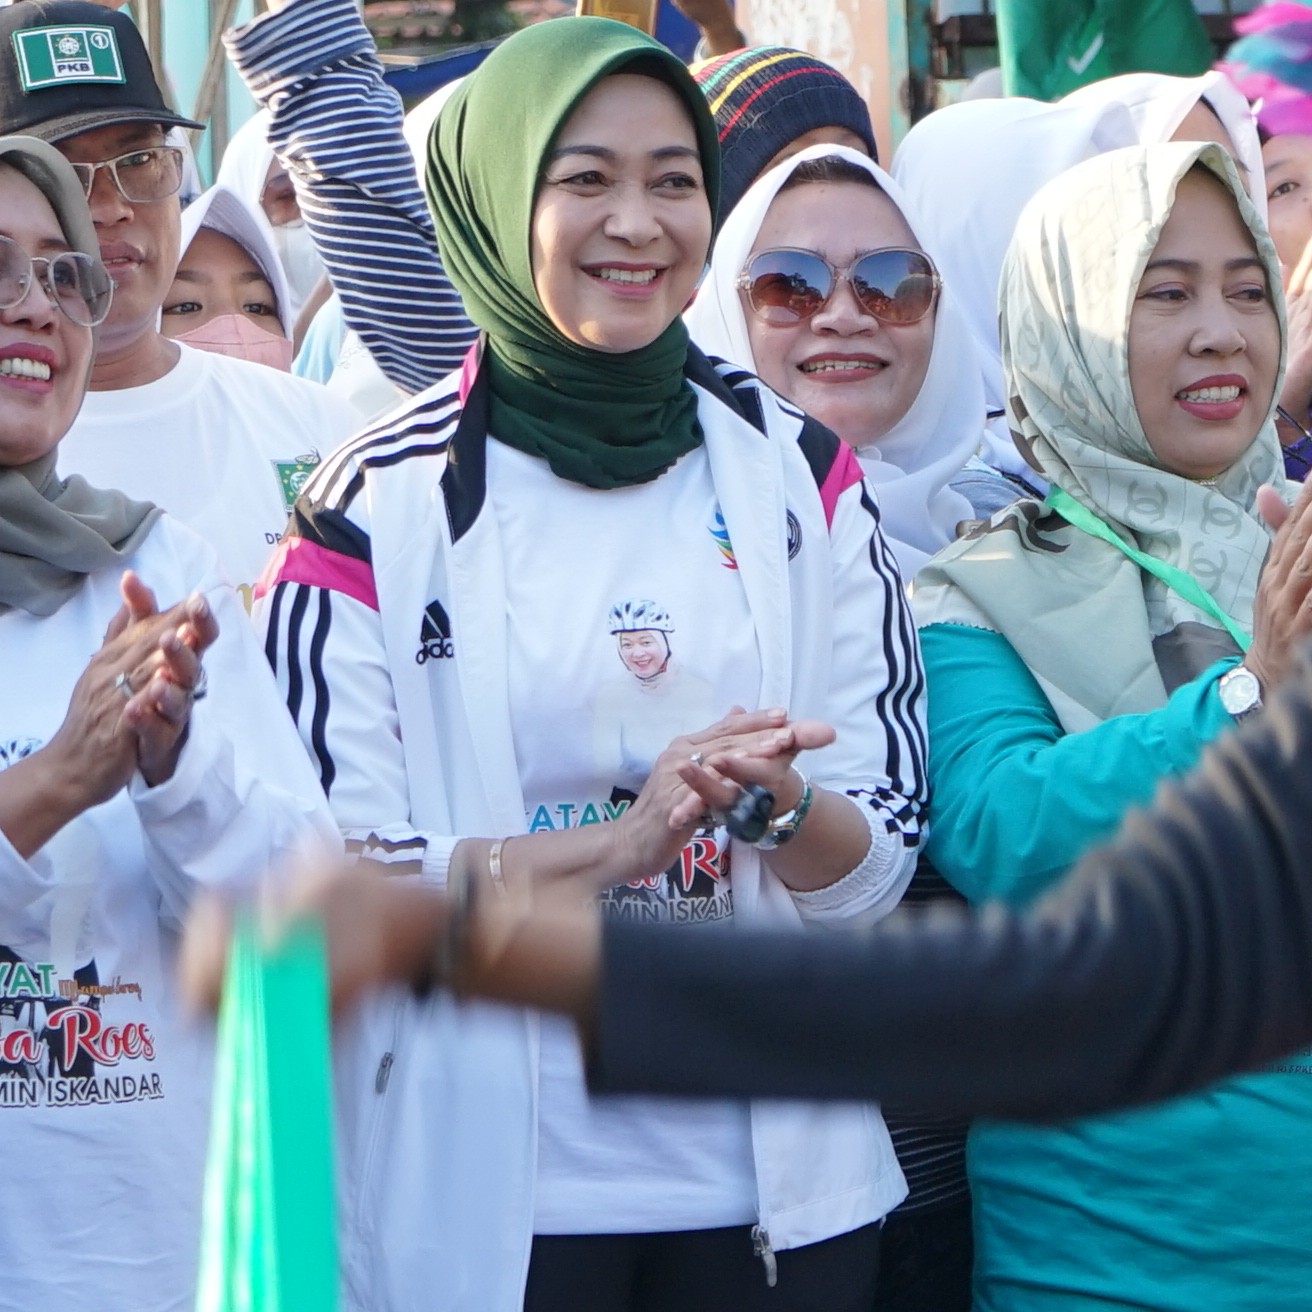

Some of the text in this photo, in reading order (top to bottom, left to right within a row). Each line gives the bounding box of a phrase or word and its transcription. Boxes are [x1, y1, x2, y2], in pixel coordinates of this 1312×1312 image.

[56, 61, 92, 76] PKB
[527, 798, 633, 836] ATAY
[47, 1005, 156, 1070] Roes
[44, 1072, 165, 1108] ISKANDAR
